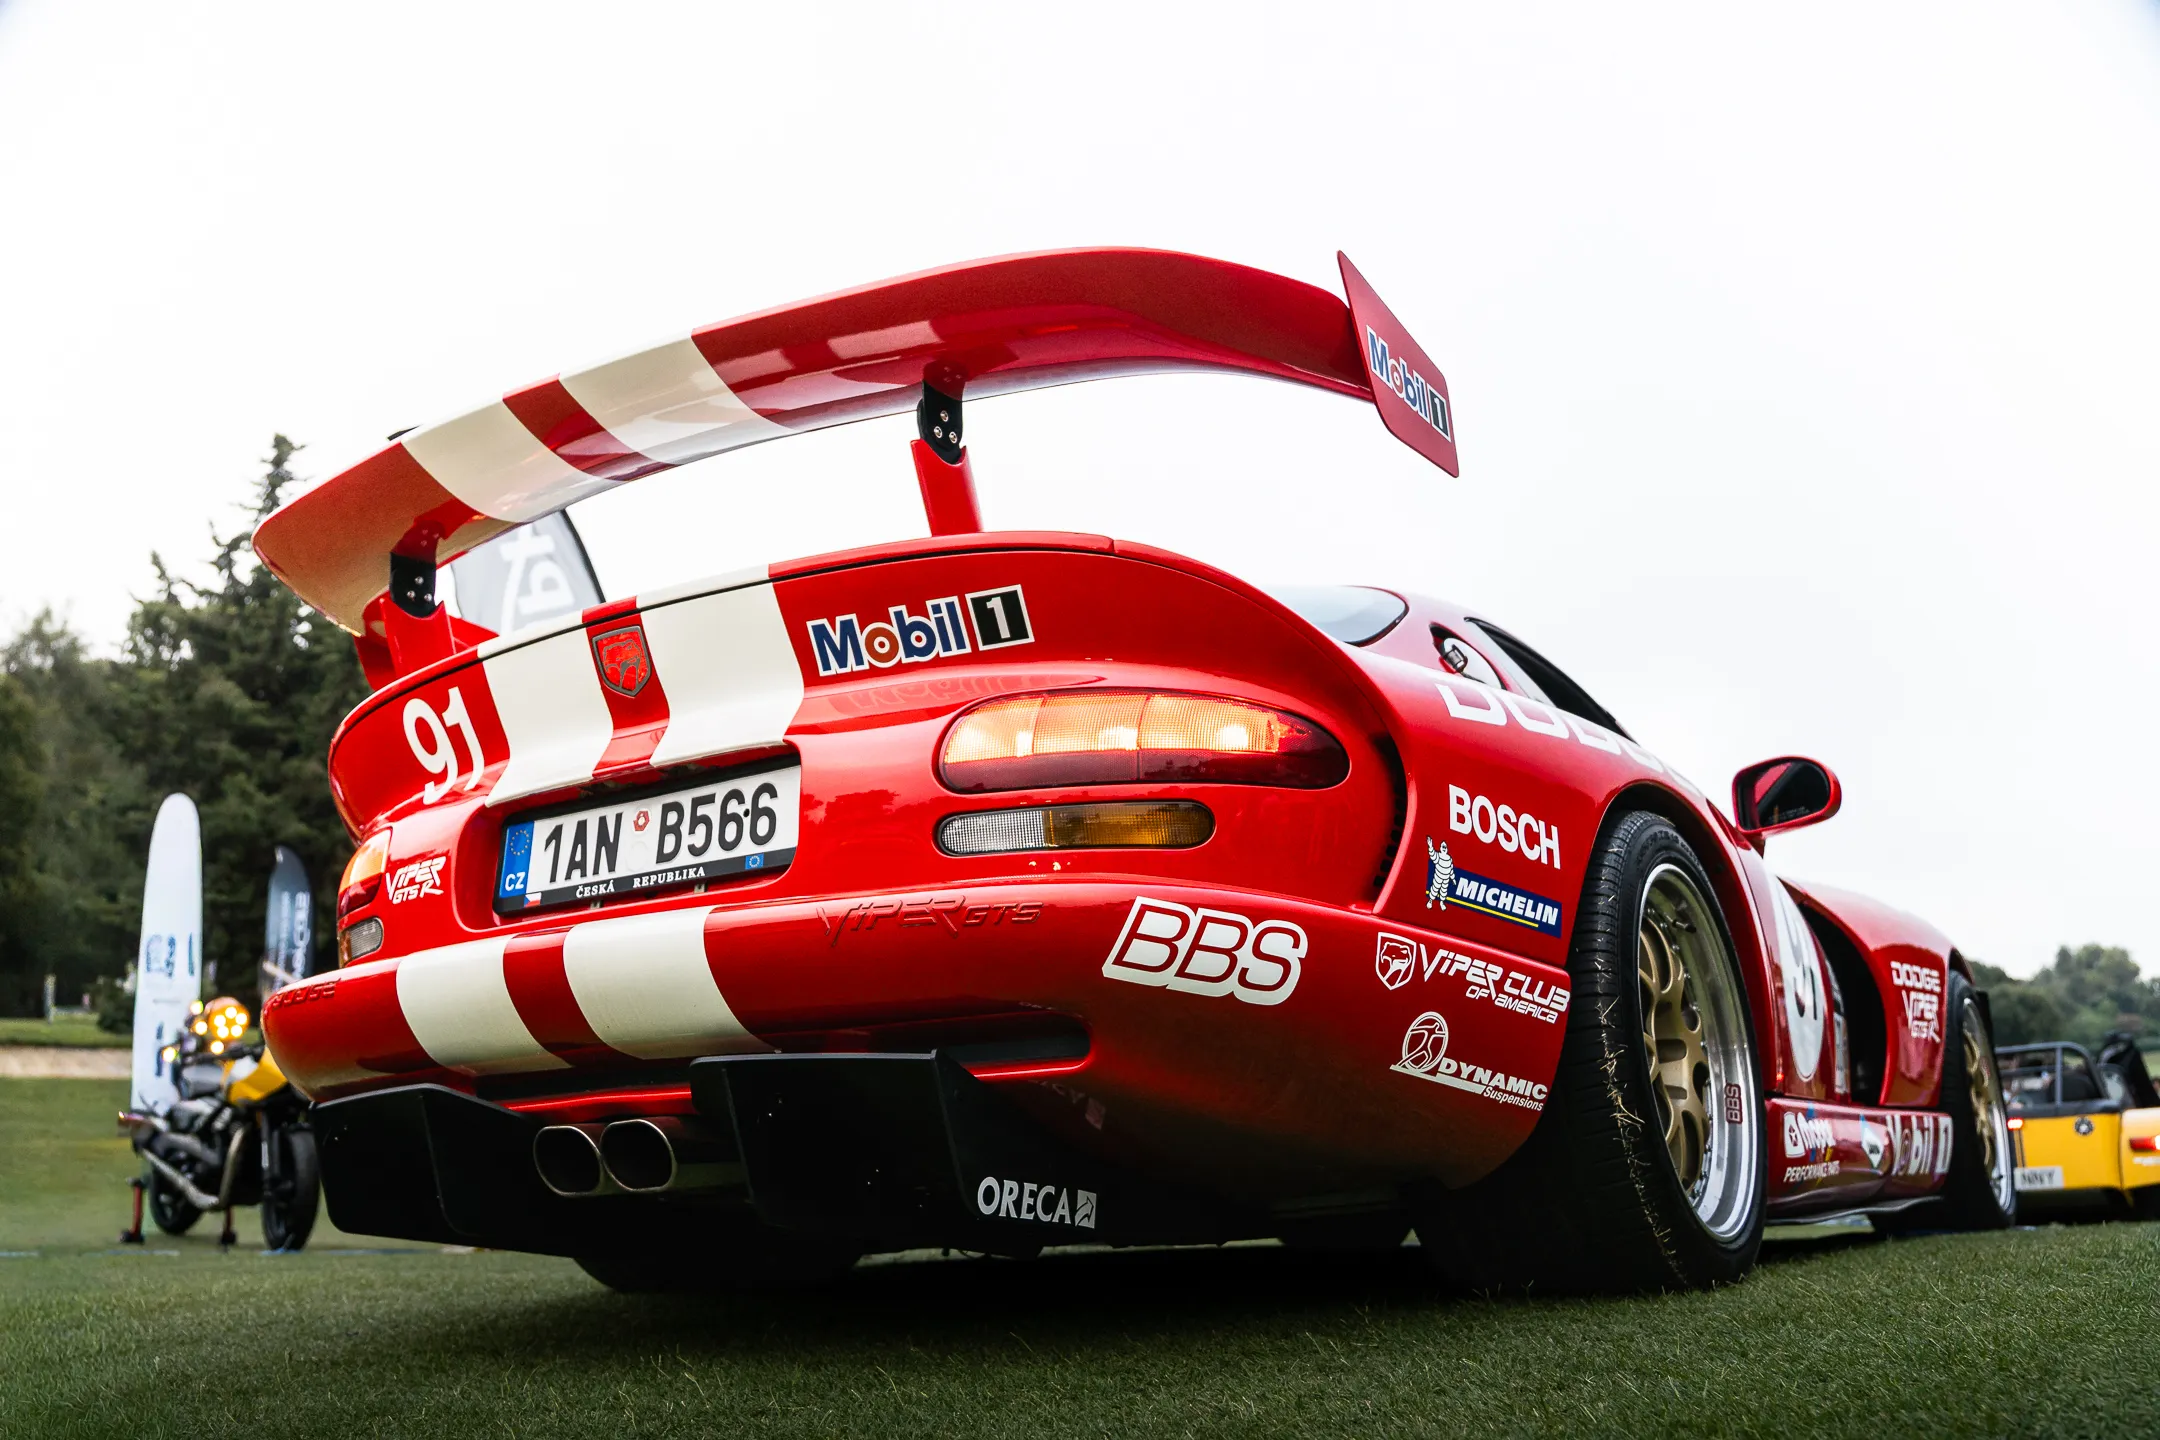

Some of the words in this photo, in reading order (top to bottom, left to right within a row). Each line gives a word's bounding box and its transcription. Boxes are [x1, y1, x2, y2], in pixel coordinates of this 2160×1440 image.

[1366, 325, 1431, 424] Mobil
[806, 596, 972, 677] Mobil
[402, 686, 486, 805] 91
[544, 812, 623, 883] 1AN
[656, 782, 779, 864] B566
[1449, 784, 1561, 869] BOSCH
[386, 856, 446, 900] VIPER
[505, 871, 526, 891] CZ
[575, 879, 615, 898] ČESKÁ
[632, 866, 705, 888] REPUBLIKA
[963, 901, 1044, 927] GTS
[1455, 877, 1558, 926] MICHELIN
[1101, 895, 1308, 1005] BBS
[1419, 943, 1504, 1000] VIPER
[1504, 972, 1571, 1012] CLUB
[1465, 985, 1491, 1000] OF
[1890, 961, 1941, 993] DODGE
[1901, 989, 1939, 1033] VIPER
[1437, 1057, 1548, 1099] DYNAMIC
[1483, 1086, 1543, 1111] Suspensions
[1725, 1083, 1742, 1124] BBS
[1886, 1113, 1934, 1176] Mobil
[977, 1176, 1072, 1225] ORECA
